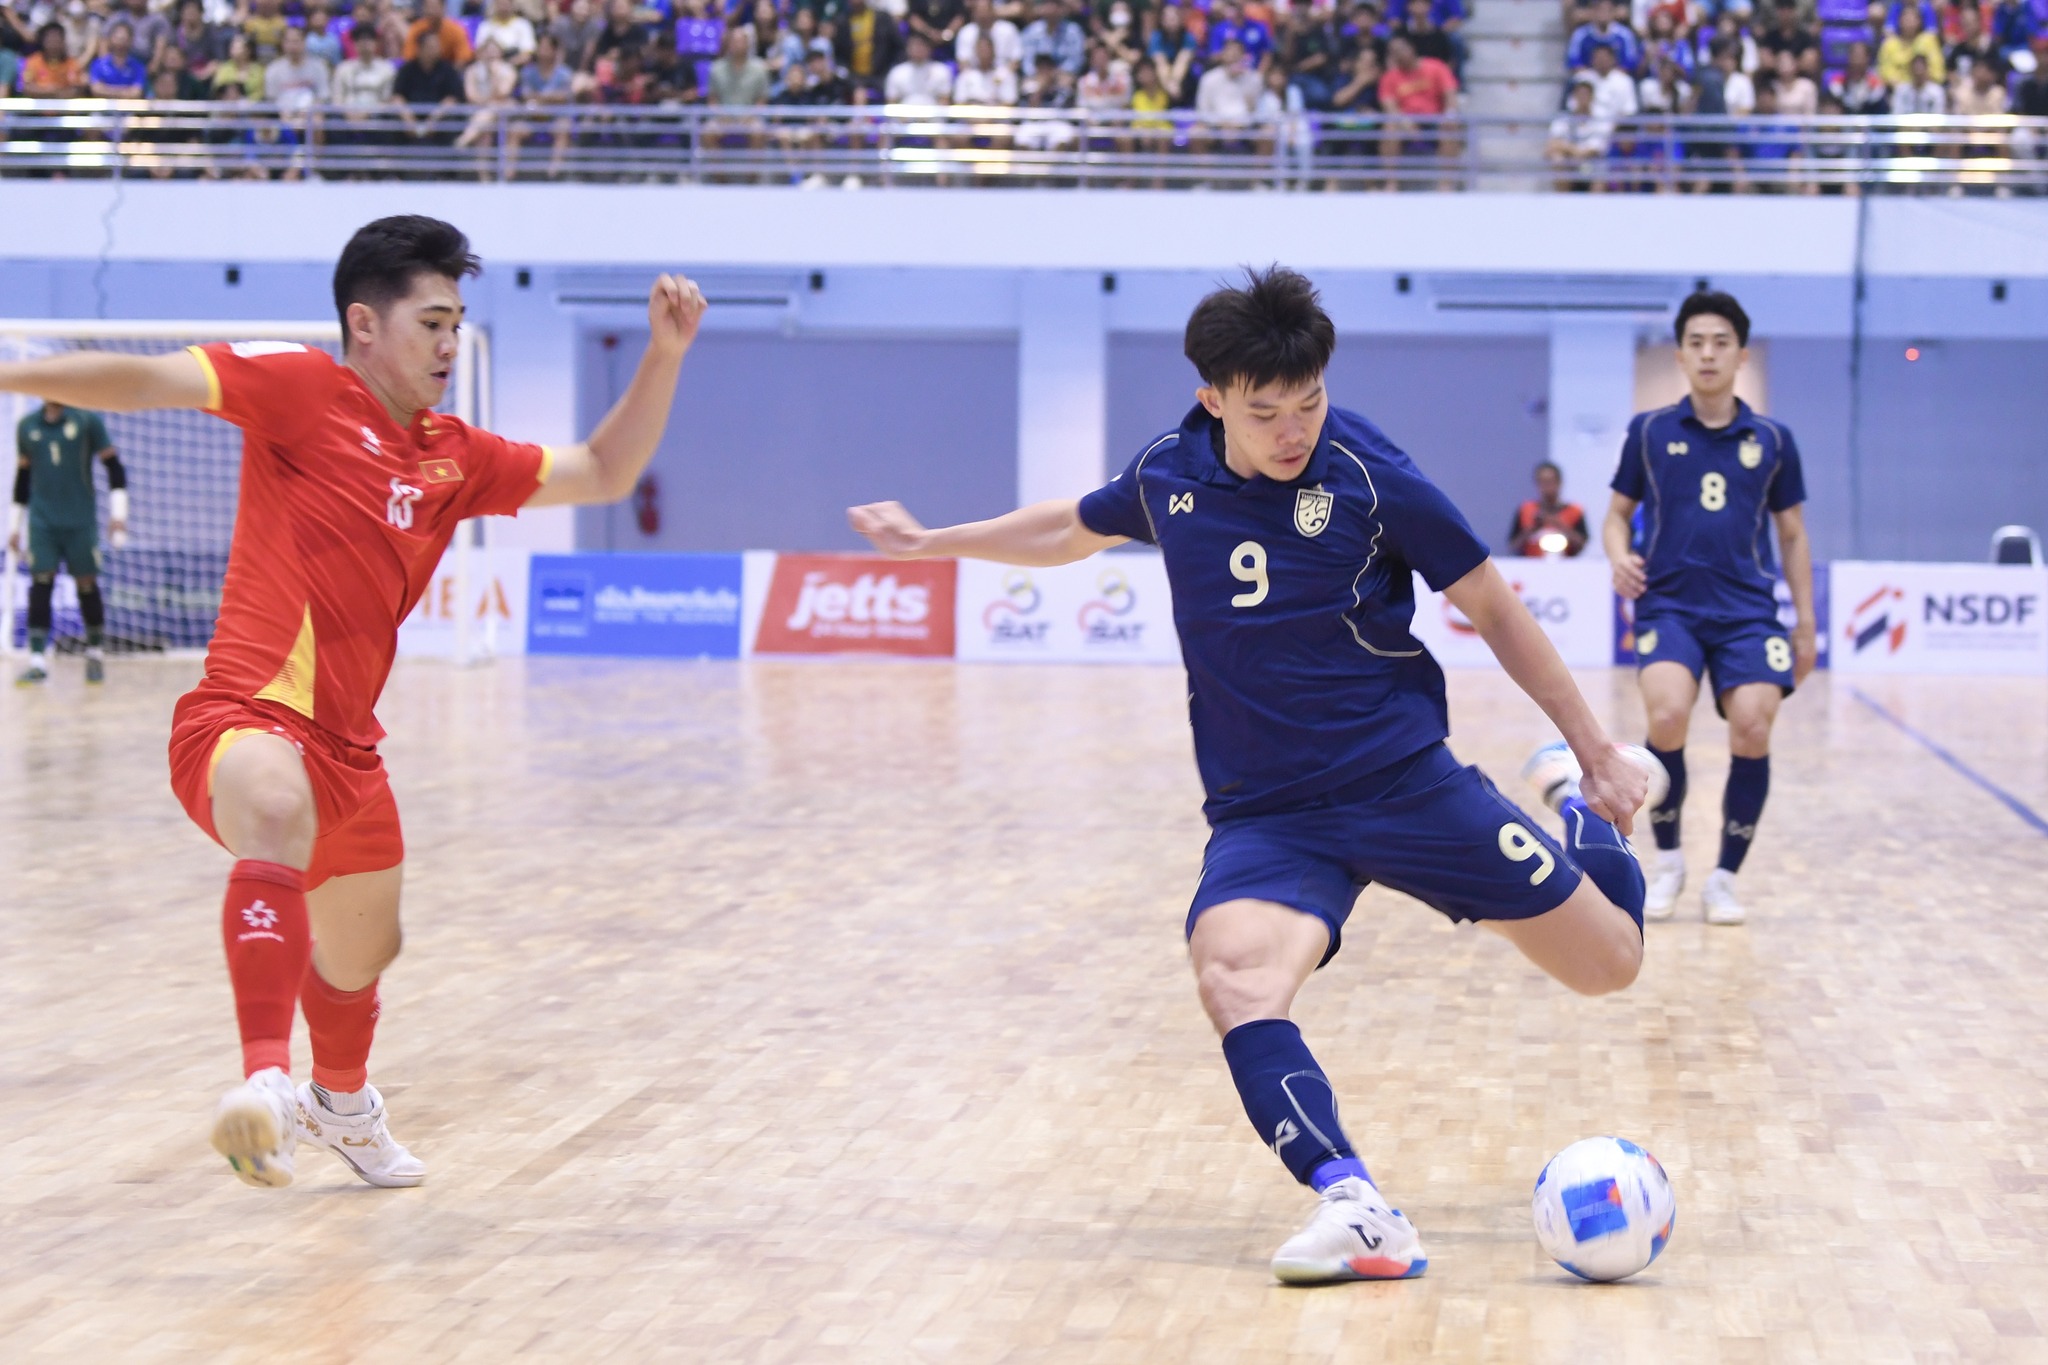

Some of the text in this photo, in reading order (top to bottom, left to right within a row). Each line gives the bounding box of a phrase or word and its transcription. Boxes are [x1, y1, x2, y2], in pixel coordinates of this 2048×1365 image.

[1700, 472, 1726, 511] 8
[1229, 541, 1269, 607] 9
[786, 571, 929, 630] jetts
[1924, 594, 2038, 625] NSDF
[1764, 636, 1792, 672] 8
[1498, 822, 1555, 886] 9
